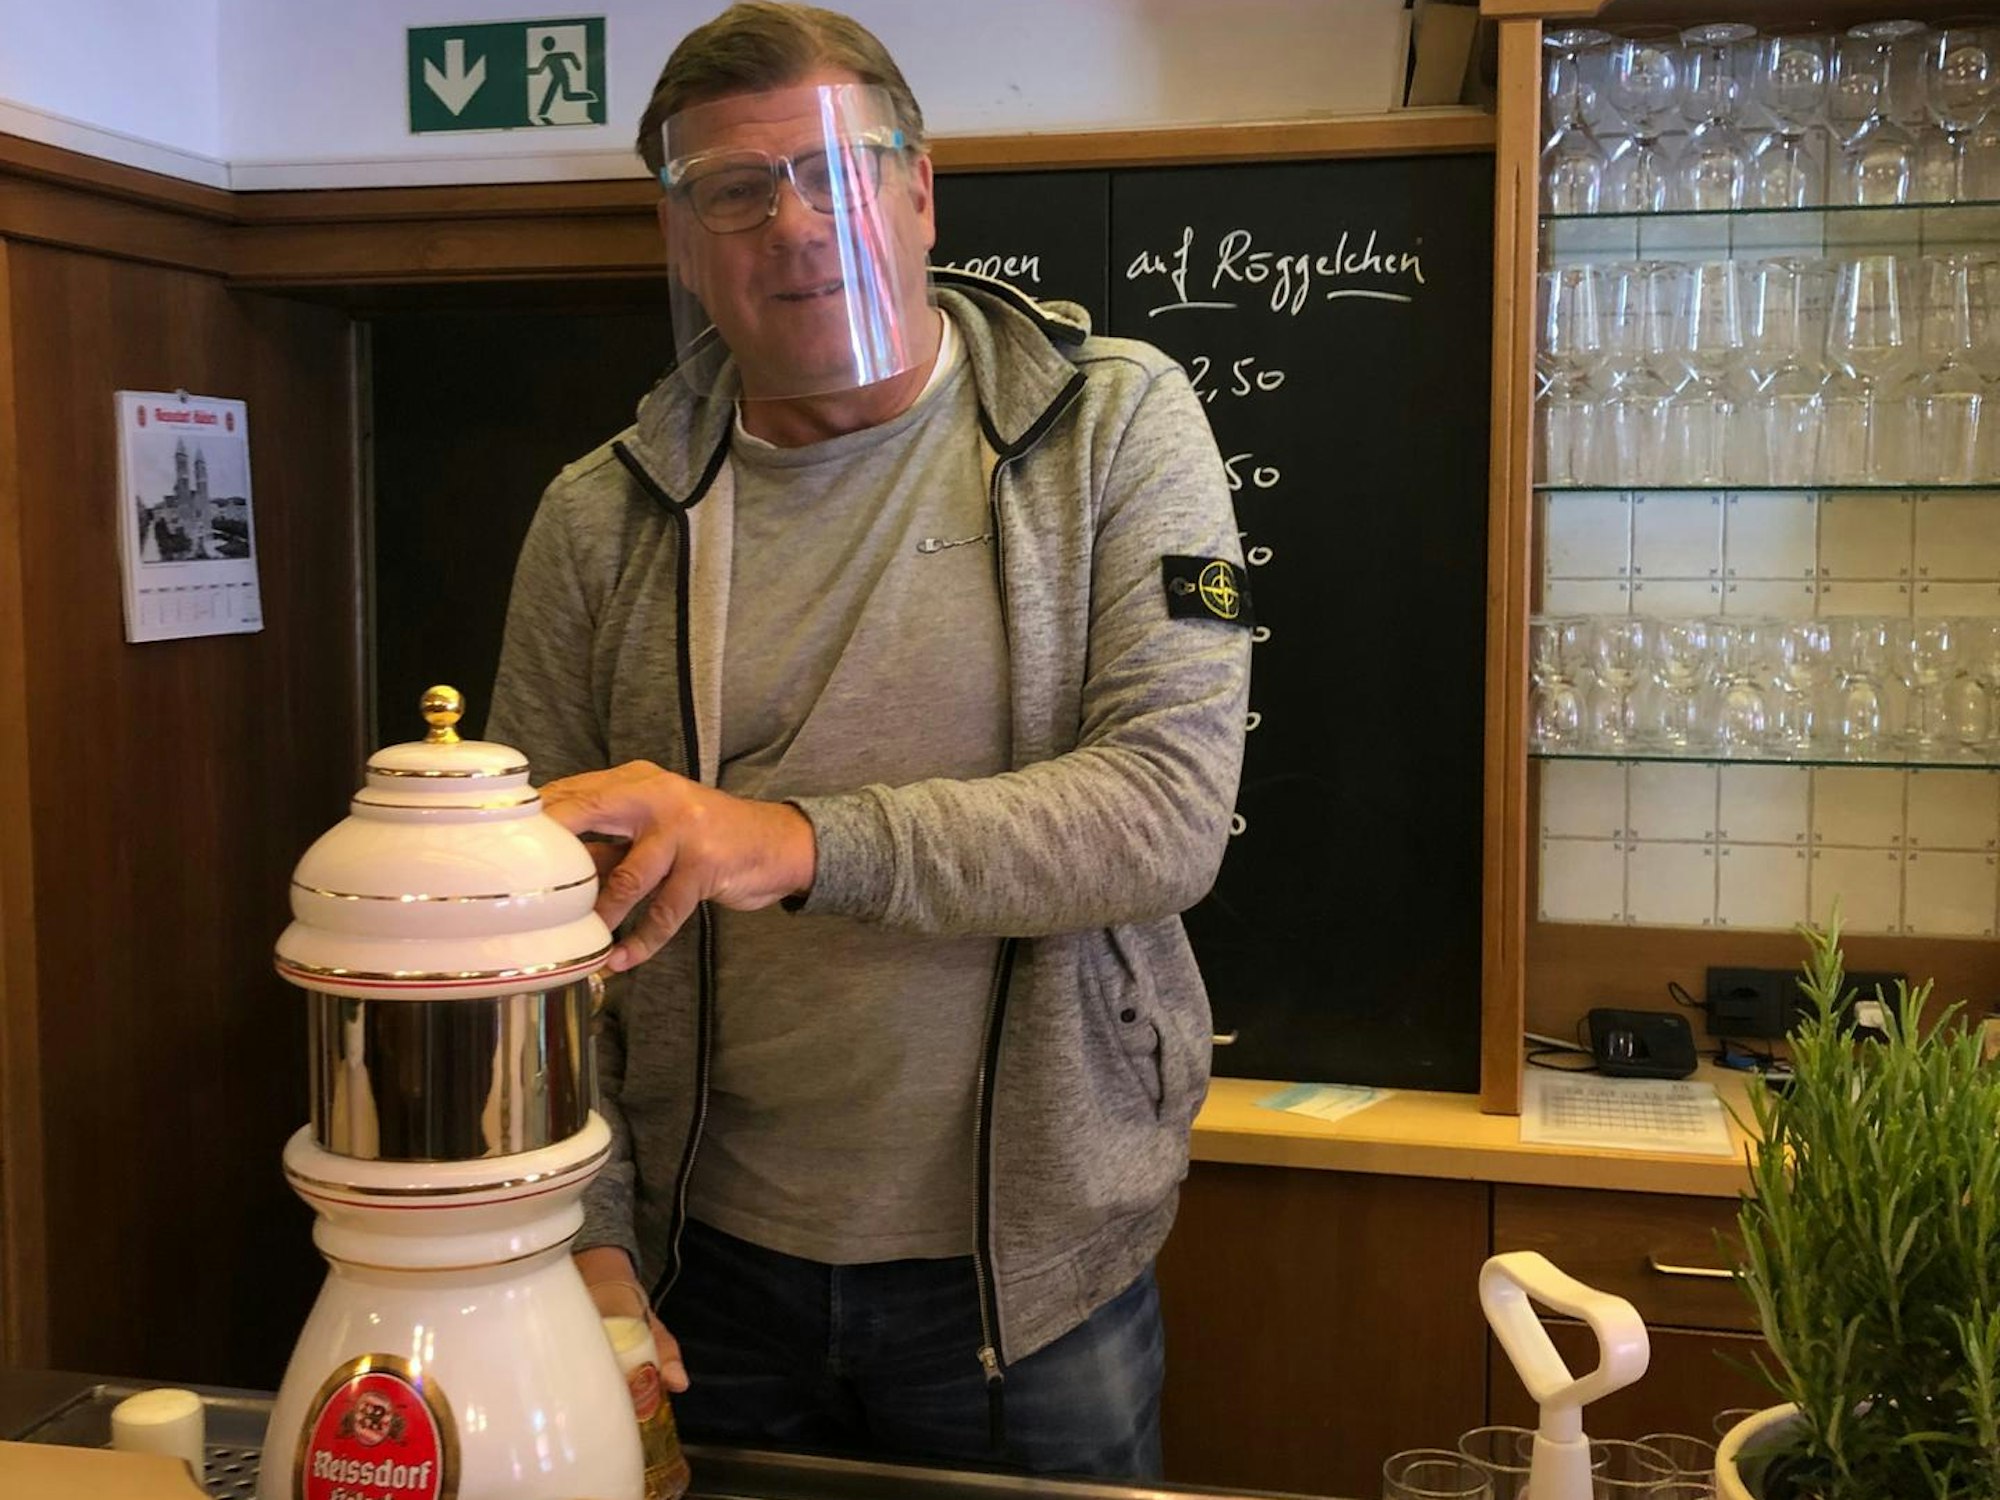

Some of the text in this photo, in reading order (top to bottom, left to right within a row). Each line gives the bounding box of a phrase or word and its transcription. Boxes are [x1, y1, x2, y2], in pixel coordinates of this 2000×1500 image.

[1127, 226, 1195, 303] auf
[1190, 356, 1286, 403] 2,50
[1224, 453, 1280, 491] 50
[313, 1449, 433, 1490] Reissdorf
